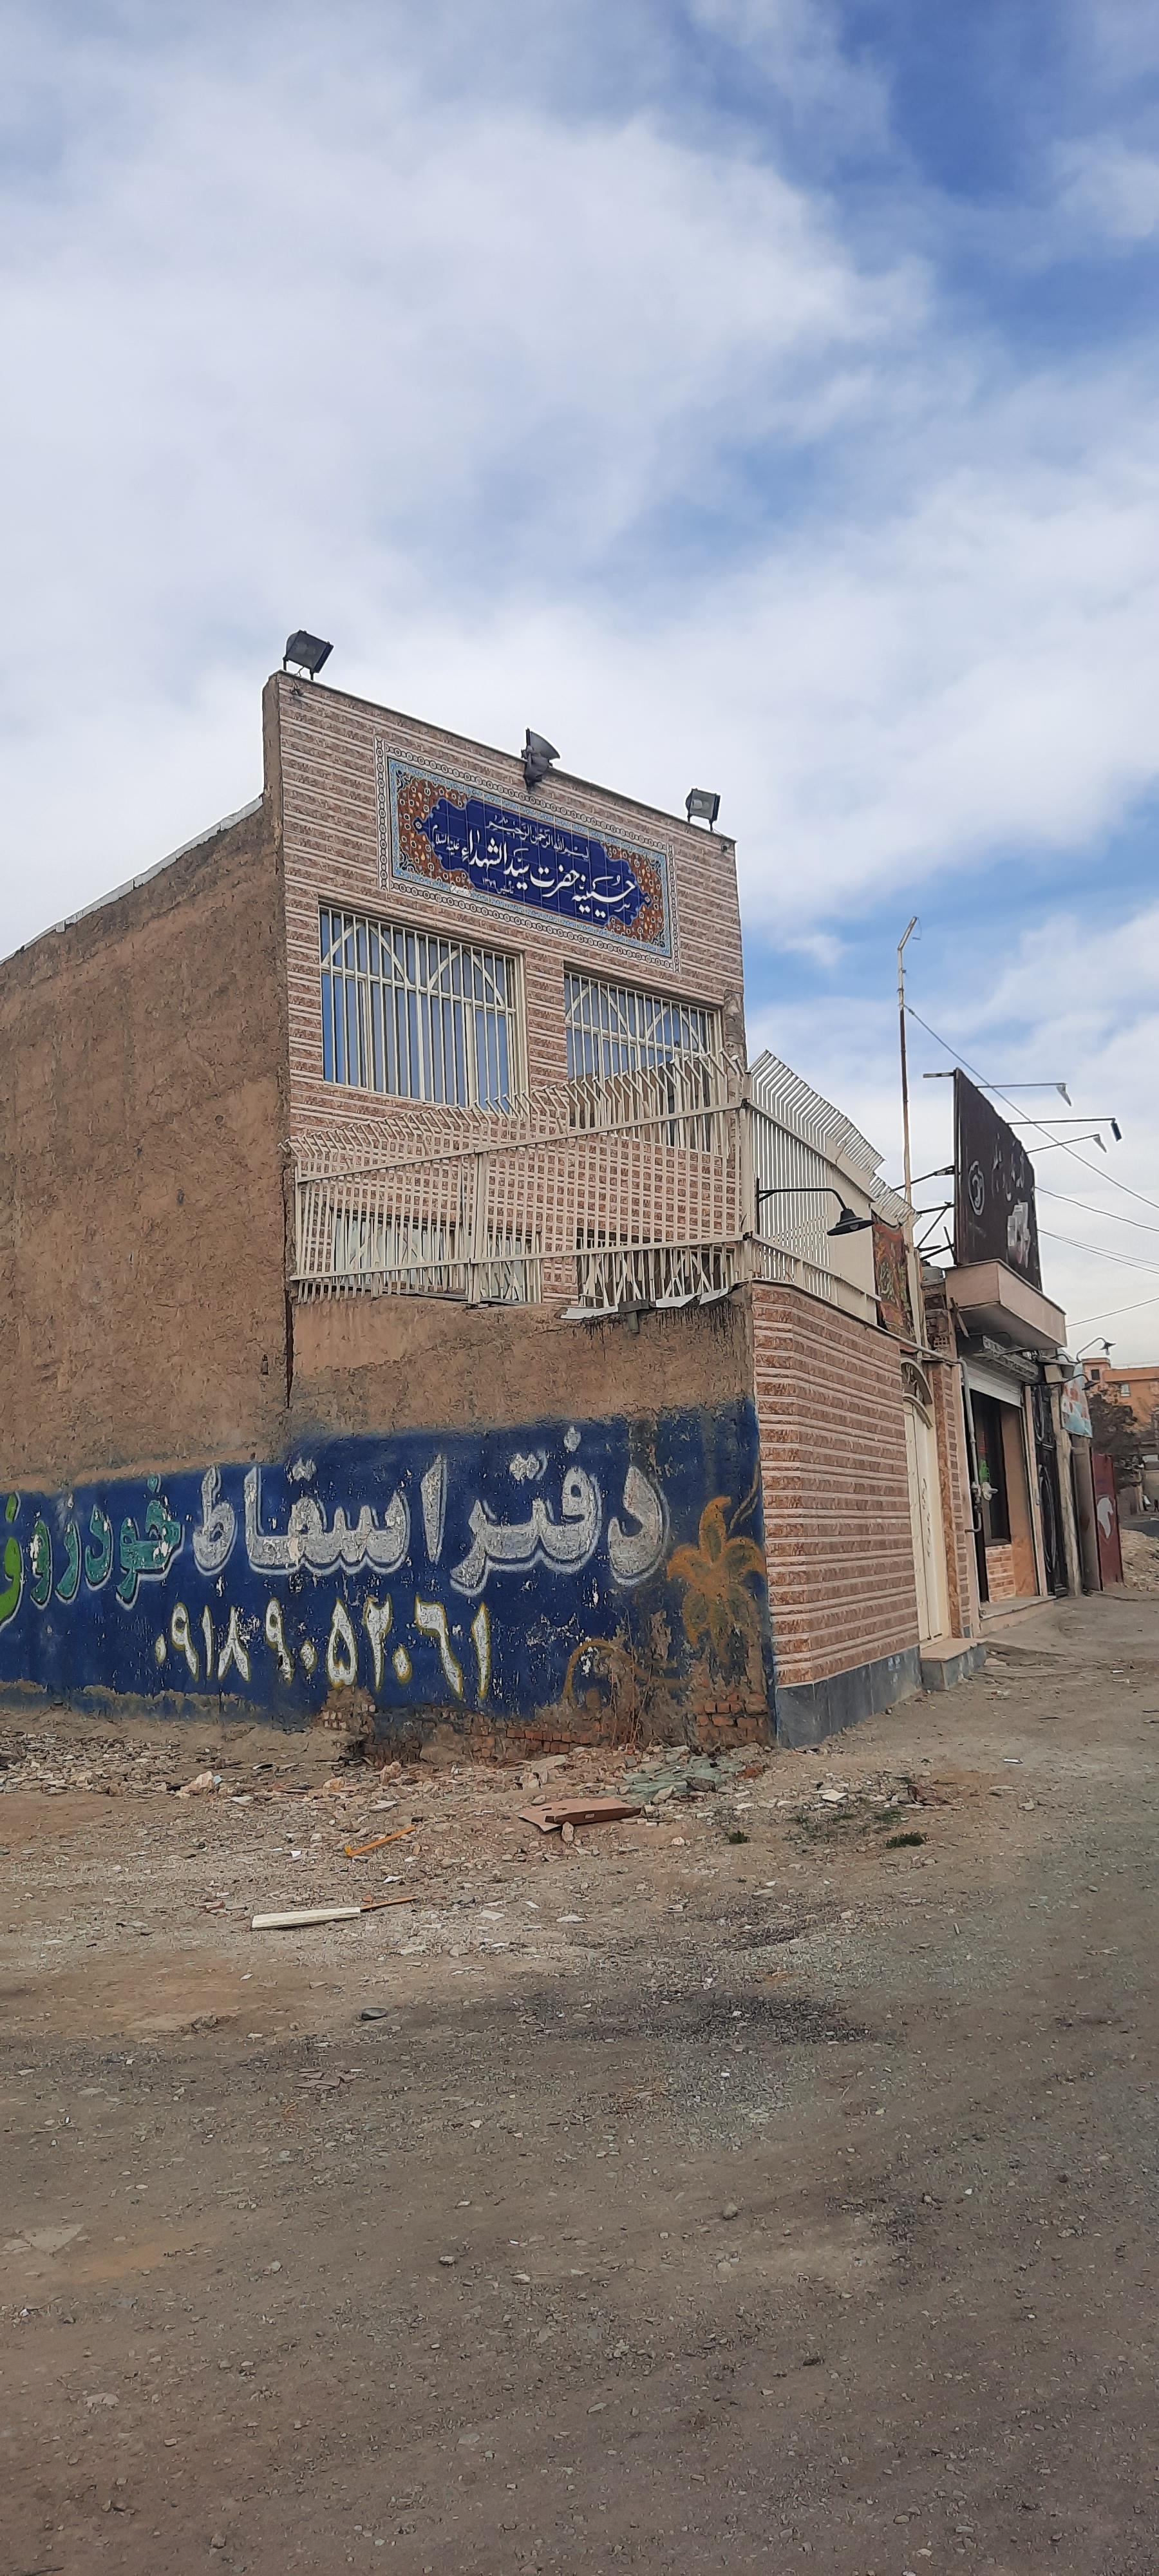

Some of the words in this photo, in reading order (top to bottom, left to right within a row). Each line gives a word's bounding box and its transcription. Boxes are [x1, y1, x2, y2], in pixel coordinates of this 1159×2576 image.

[530, 864, 580, 898] حضرت
[559, 845, 590, 861] بسم
[30, 1473, 185, 1609] خودرو
[194, 1454, 449, 1577] اسقاط
[451, 1425, 670, 1598] دفتر
